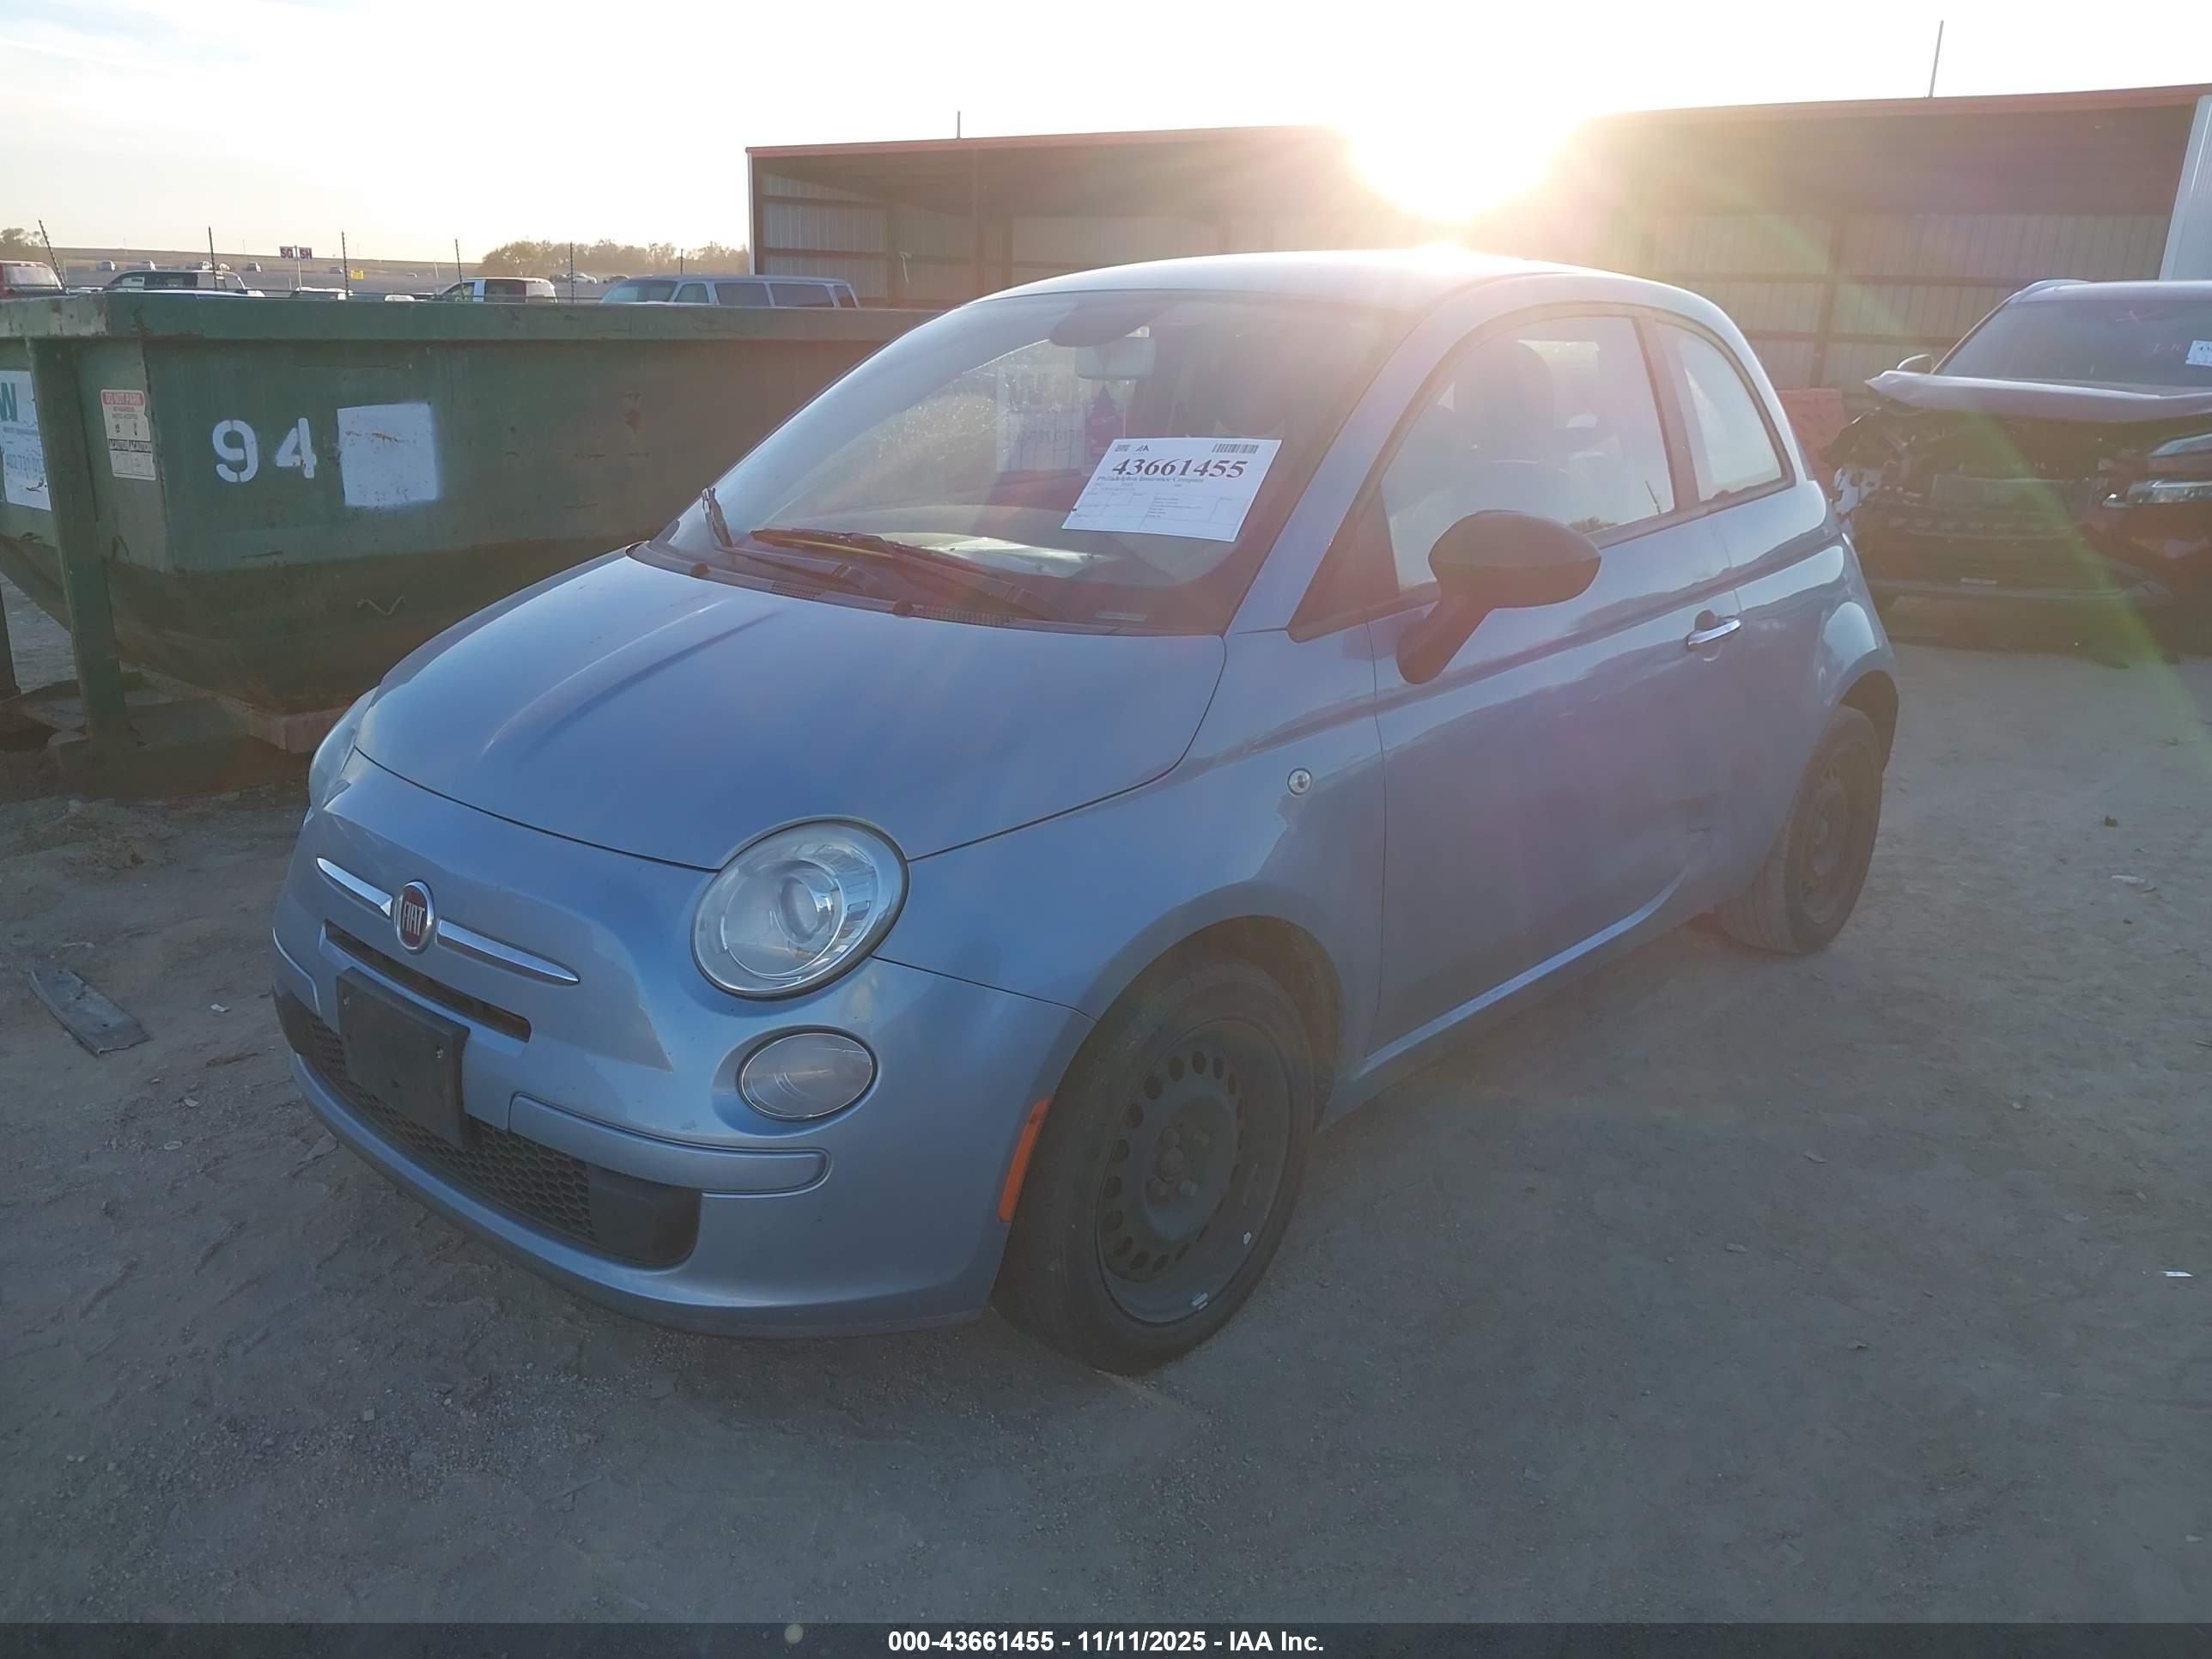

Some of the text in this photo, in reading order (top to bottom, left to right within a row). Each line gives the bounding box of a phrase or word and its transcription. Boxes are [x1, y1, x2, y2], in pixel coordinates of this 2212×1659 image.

[212, 417, 317, 483] 94
[1112, 459, 1249, 478] 43661455
[402, 901, 425, 936] FIAT
